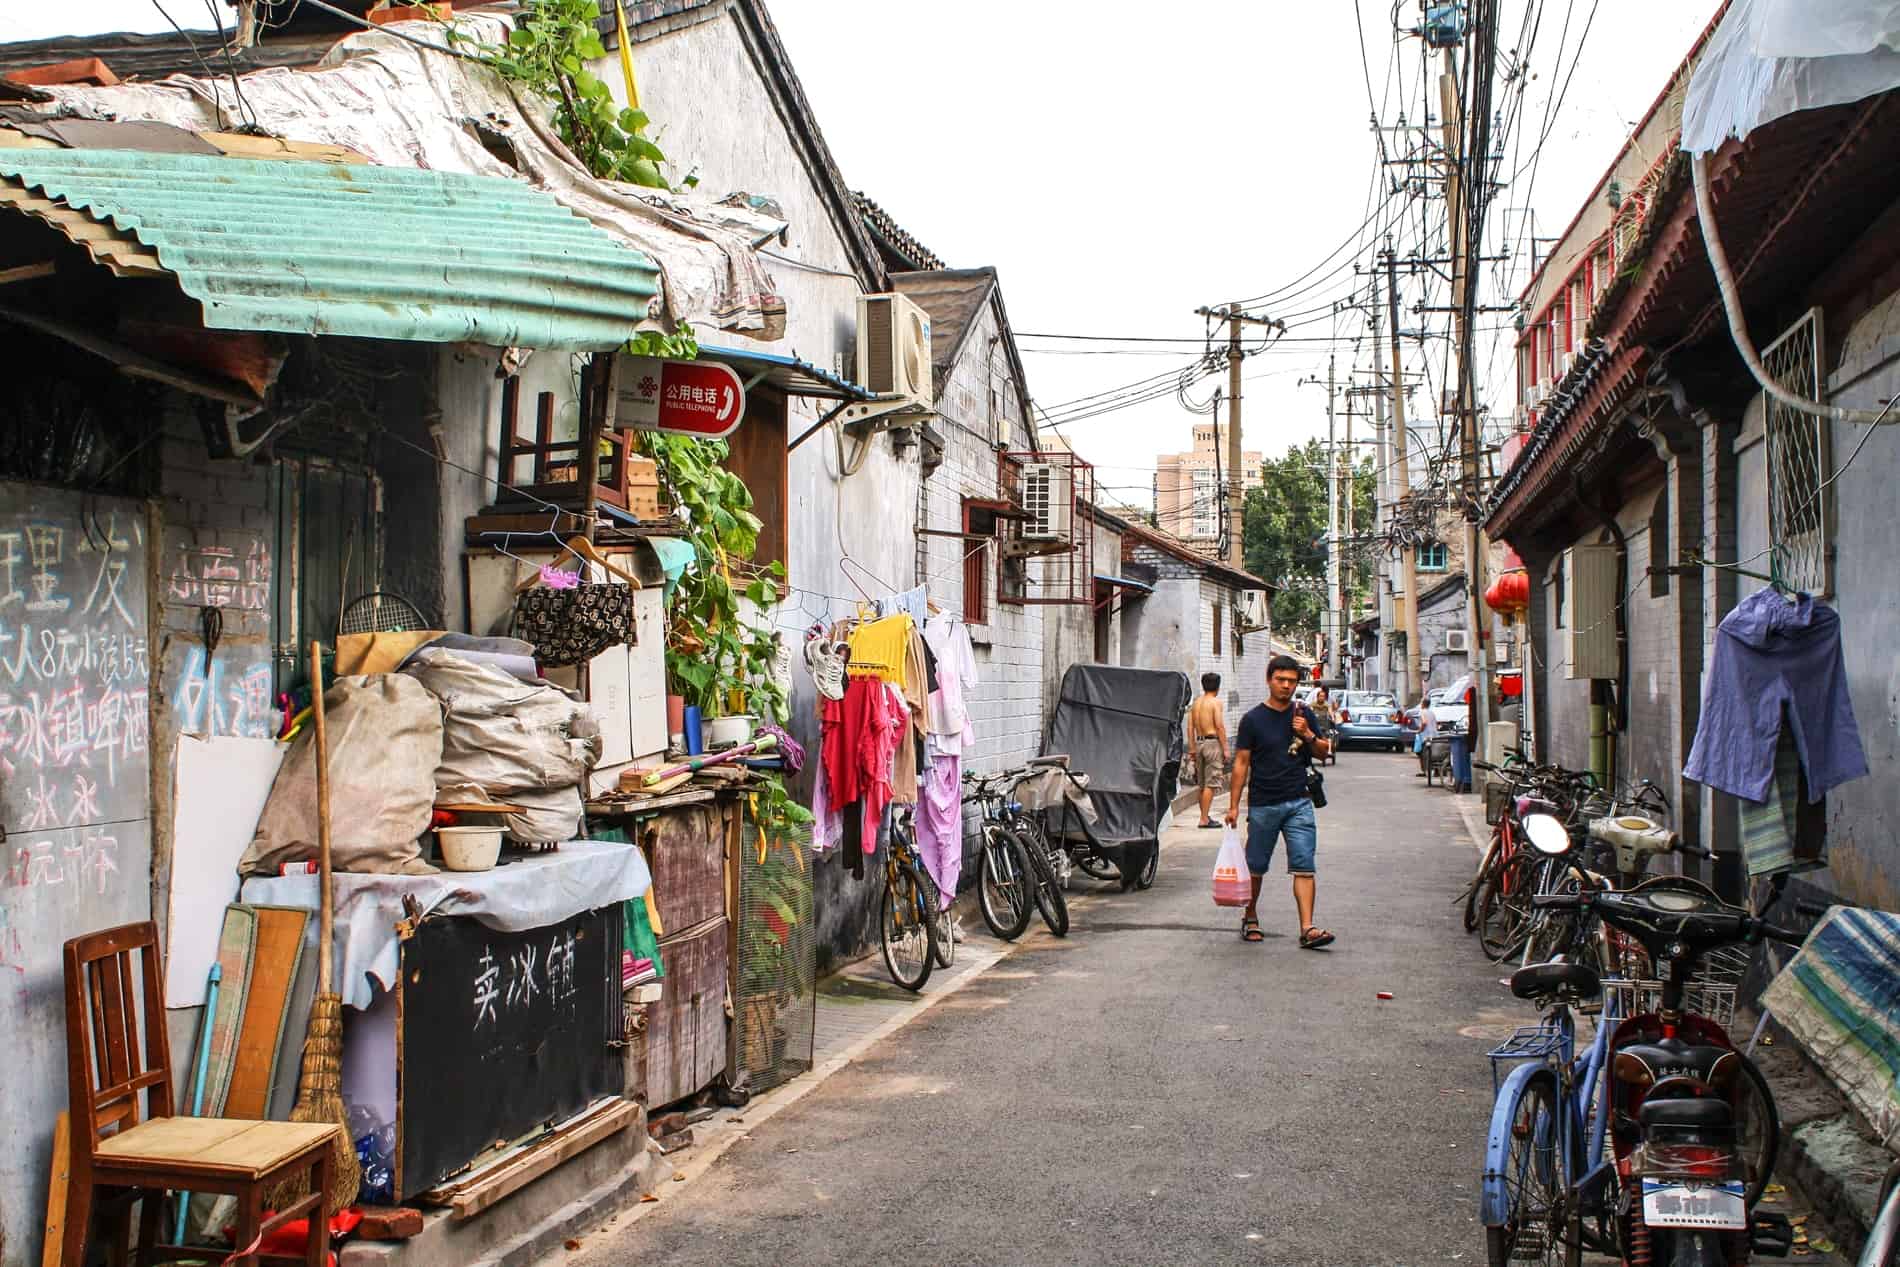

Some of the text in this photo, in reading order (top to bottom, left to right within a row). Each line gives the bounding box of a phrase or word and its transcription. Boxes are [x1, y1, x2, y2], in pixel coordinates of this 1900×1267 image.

[666, 384, 718, 404] 公用电话
[665, 400, 716, 414] PUBLIC TELEPHONE
[473, 930, 577, 1031] 卖冰镇
